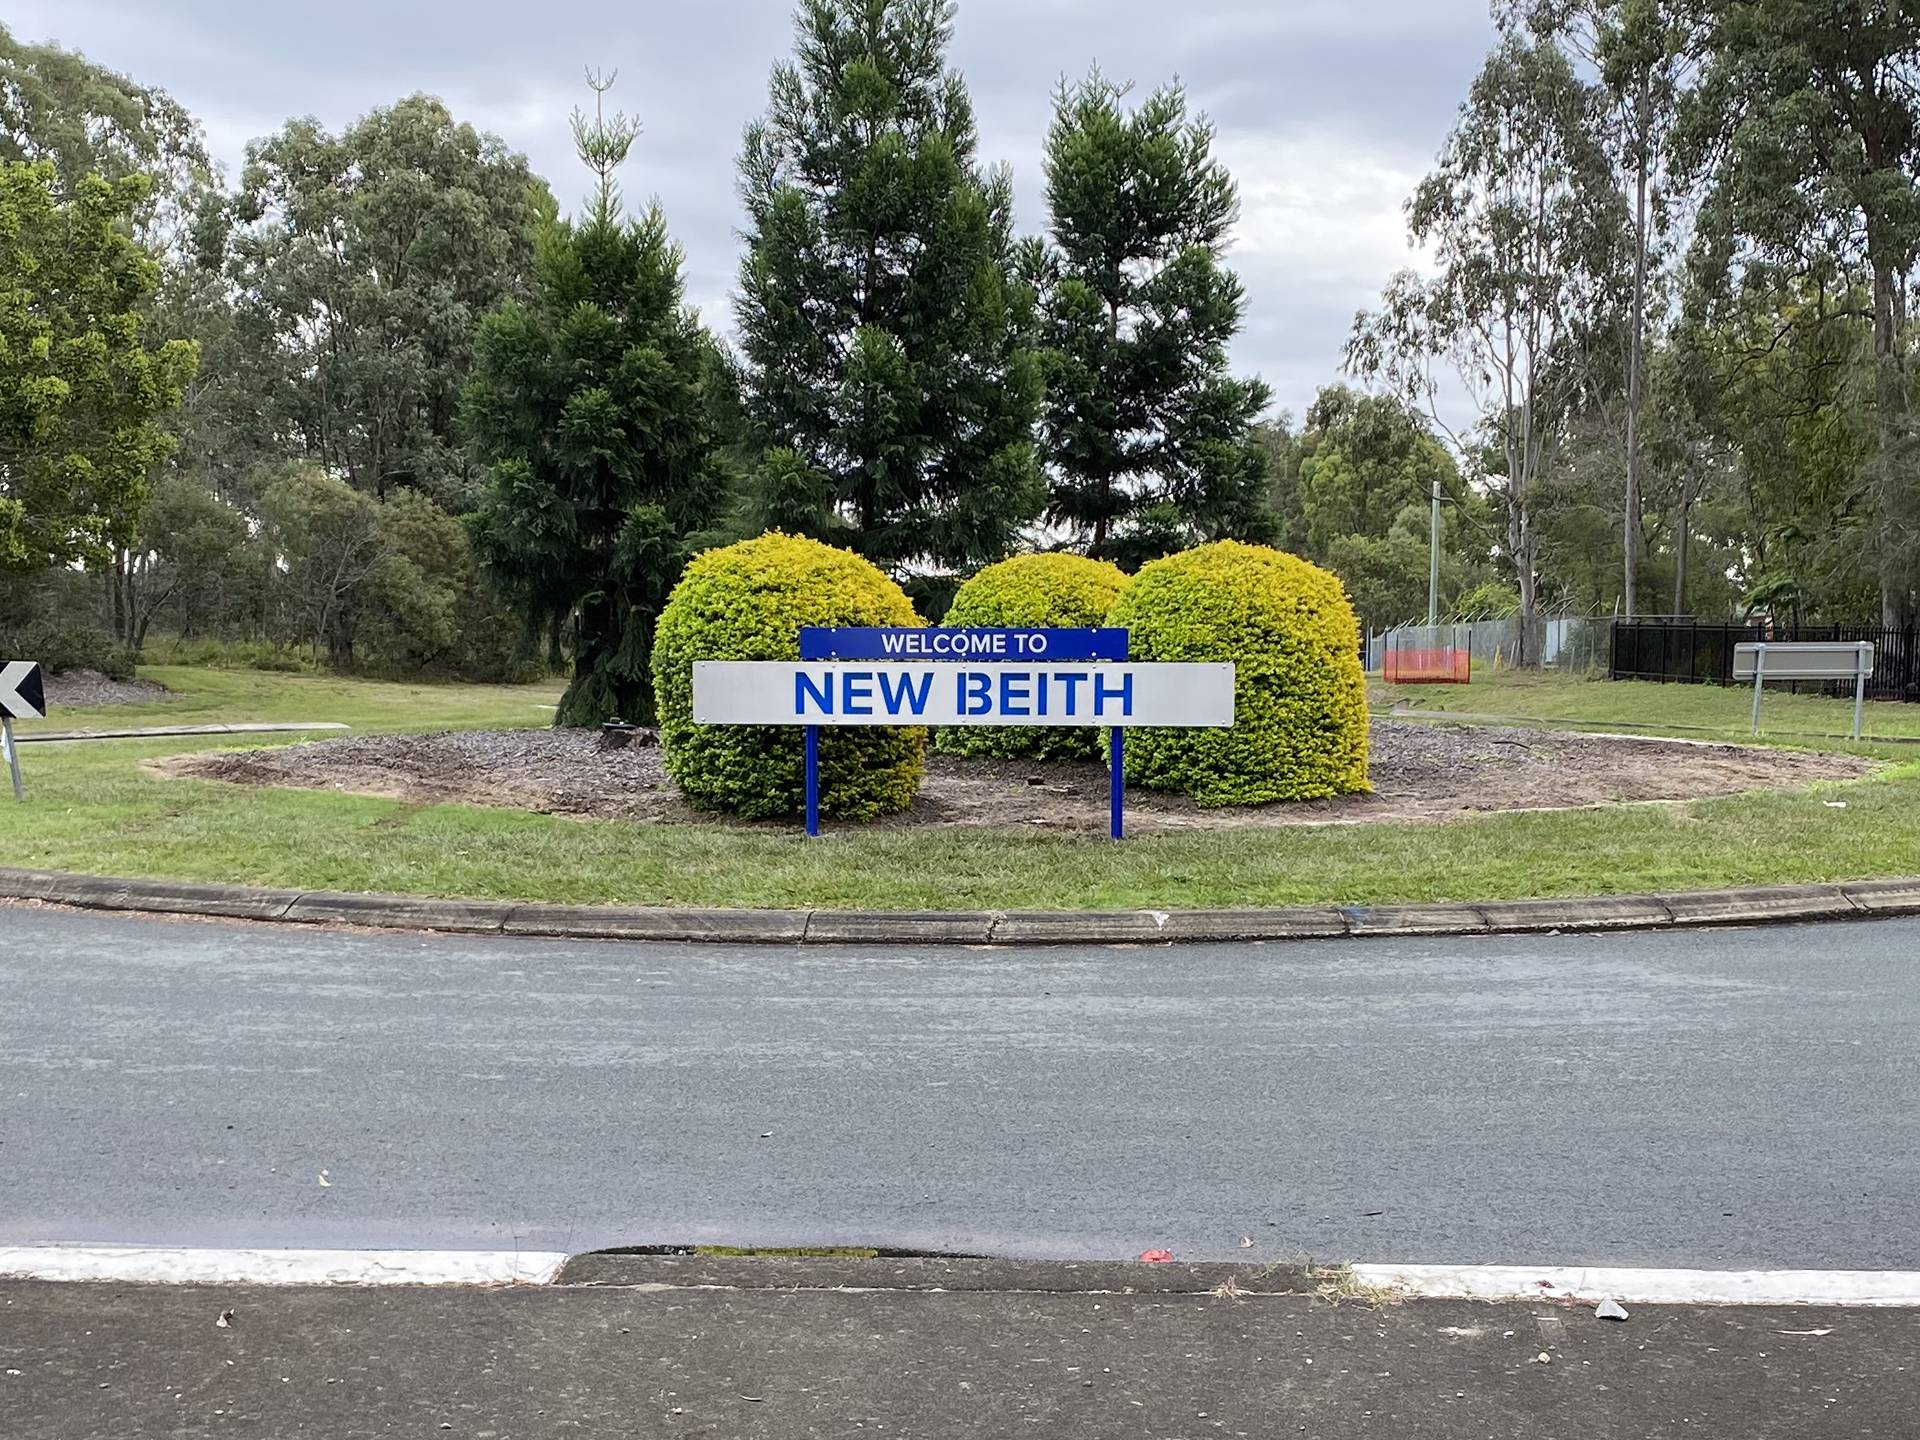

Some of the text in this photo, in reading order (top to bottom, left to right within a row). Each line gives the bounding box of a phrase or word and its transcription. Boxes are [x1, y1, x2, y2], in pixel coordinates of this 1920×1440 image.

[882, 633, 1047, 654] WELCOME TO
[795, 672, 1134, 716] NEW BEITH
